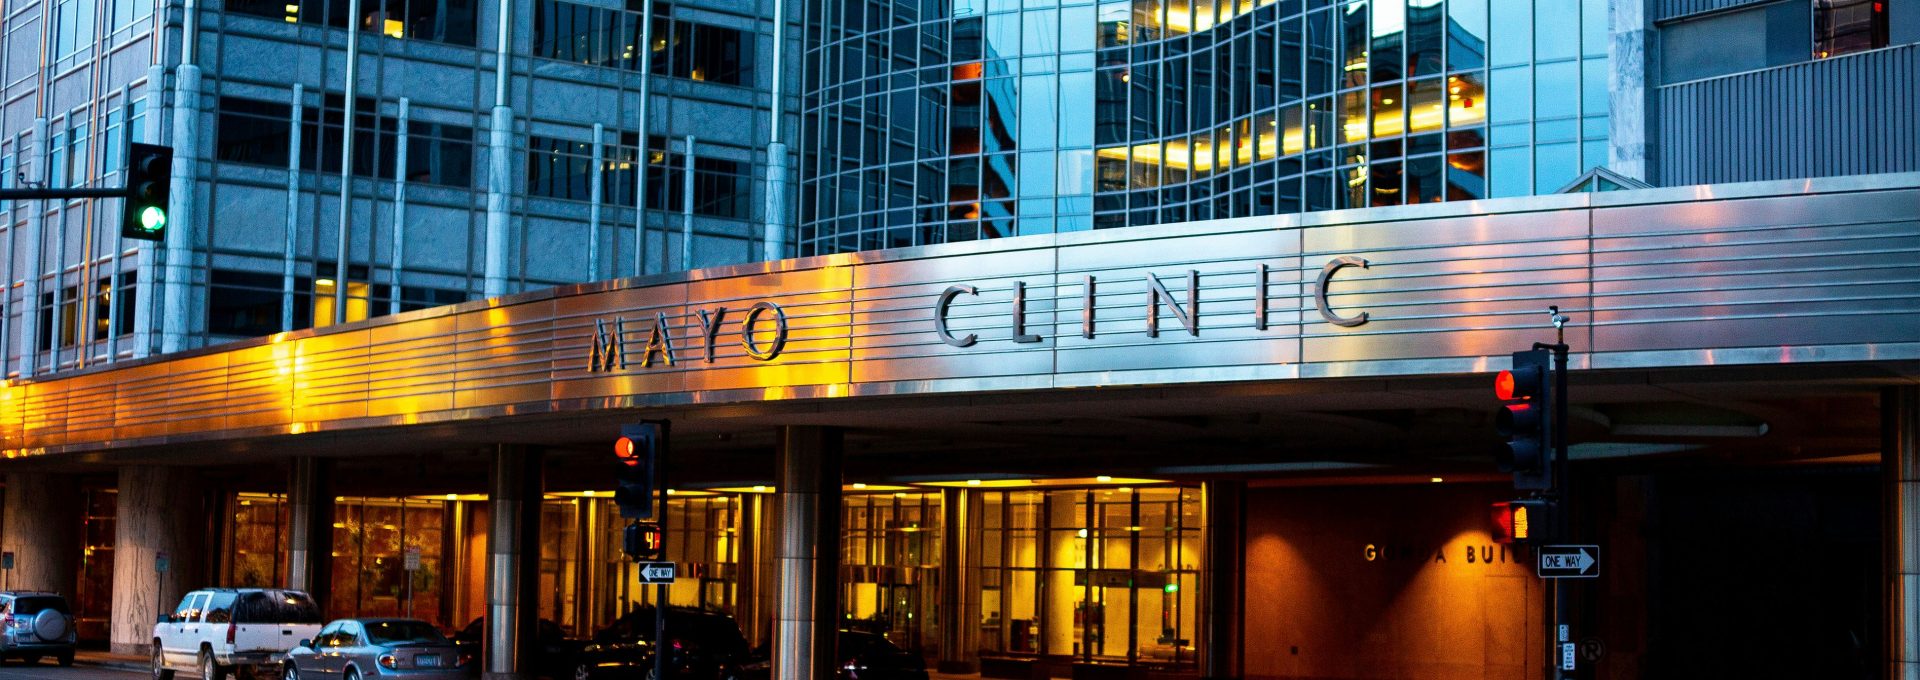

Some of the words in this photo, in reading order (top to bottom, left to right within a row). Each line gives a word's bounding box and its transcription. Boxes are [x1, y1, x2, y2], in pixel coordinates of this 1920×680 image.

[587, 302, 788, 372] MAYO
[935, 256, 1369, 347] CLINIC
[1545, 556, 1560, 567] ONE
[1565, 555, 1581, 567] WAY
[648, 568, 658, 577] ONE
[661, 568, 671, 577] WAY
